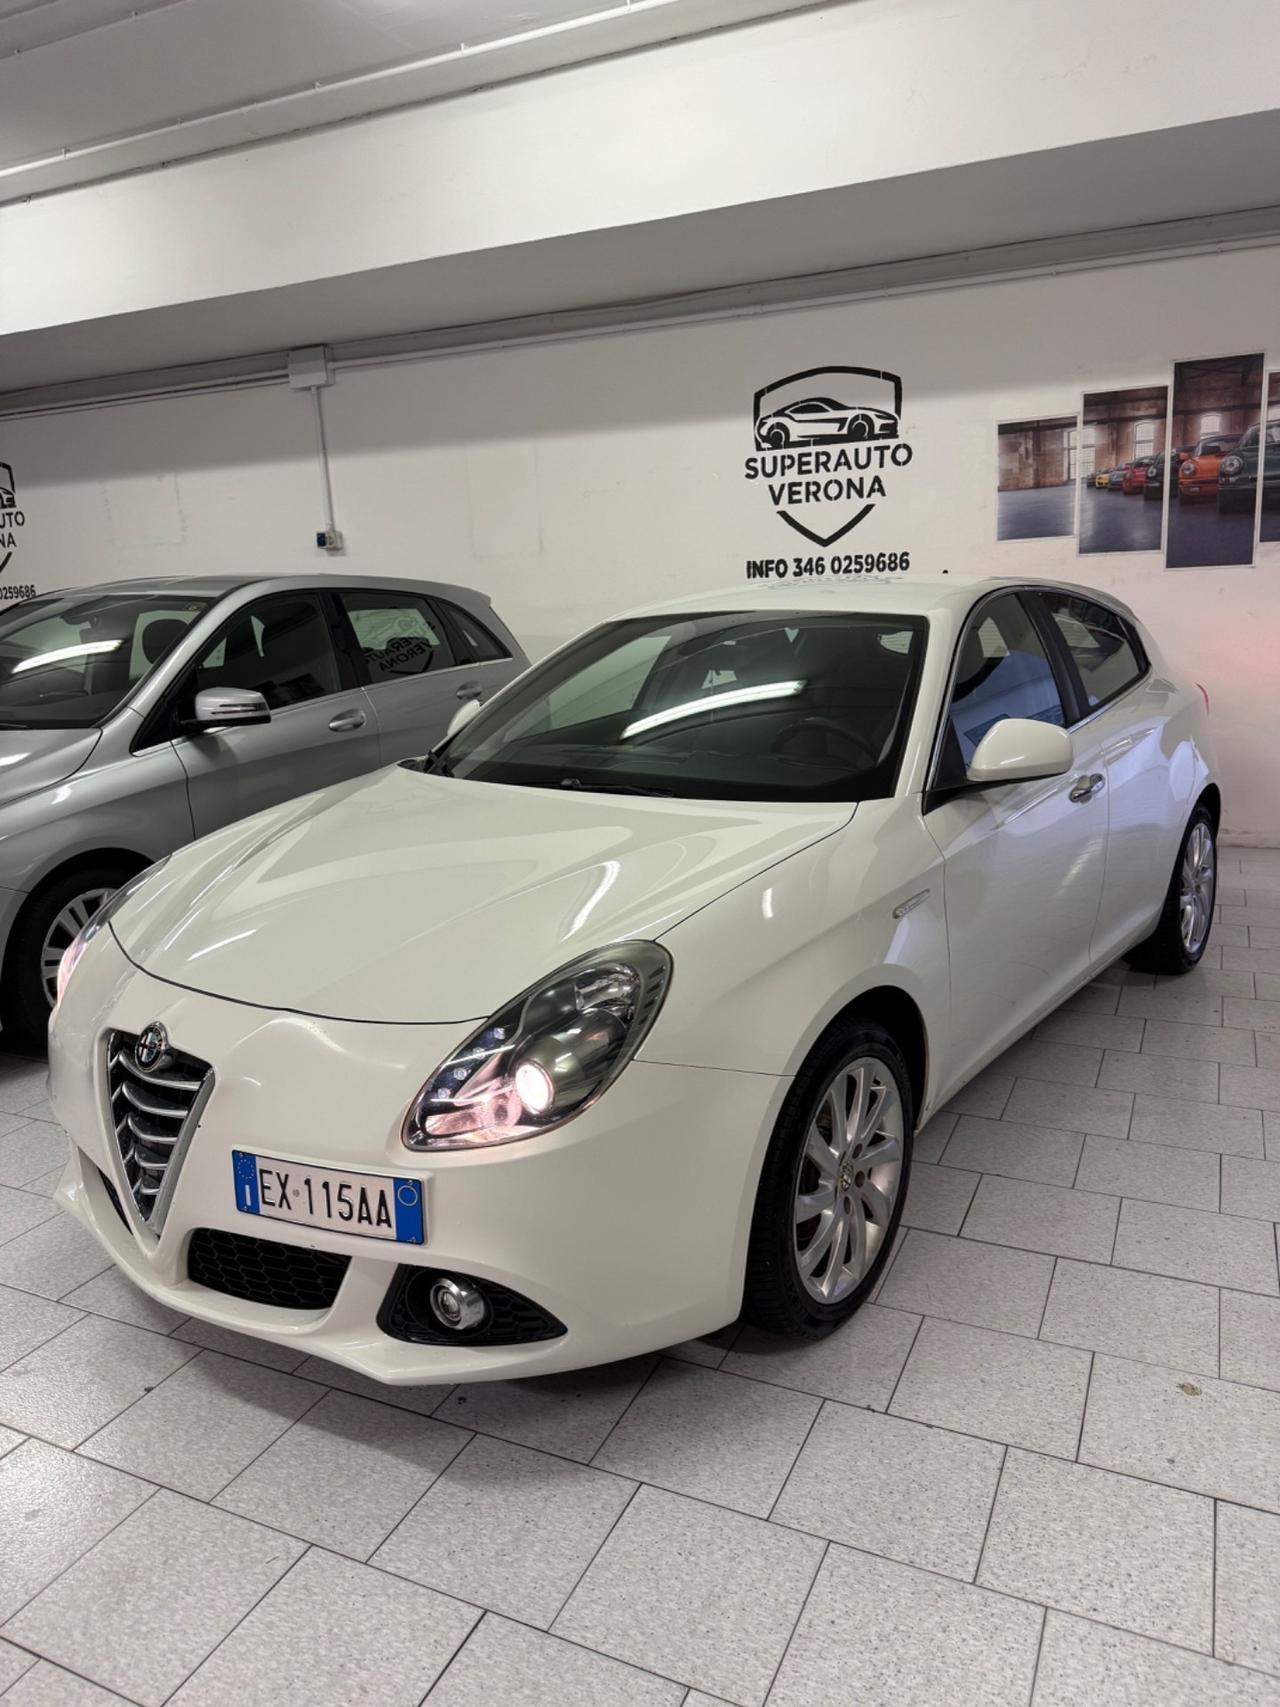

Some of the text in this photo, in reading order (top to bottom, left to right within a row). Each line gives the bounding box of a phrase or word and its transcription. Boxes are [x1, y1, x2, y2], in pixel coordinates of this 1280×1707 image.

[744, 443, 913, 480] SUPERAUTO
[768, 475, 887, 506] VERONA
[746, 551, 910, 579] INFO 346 0259686
